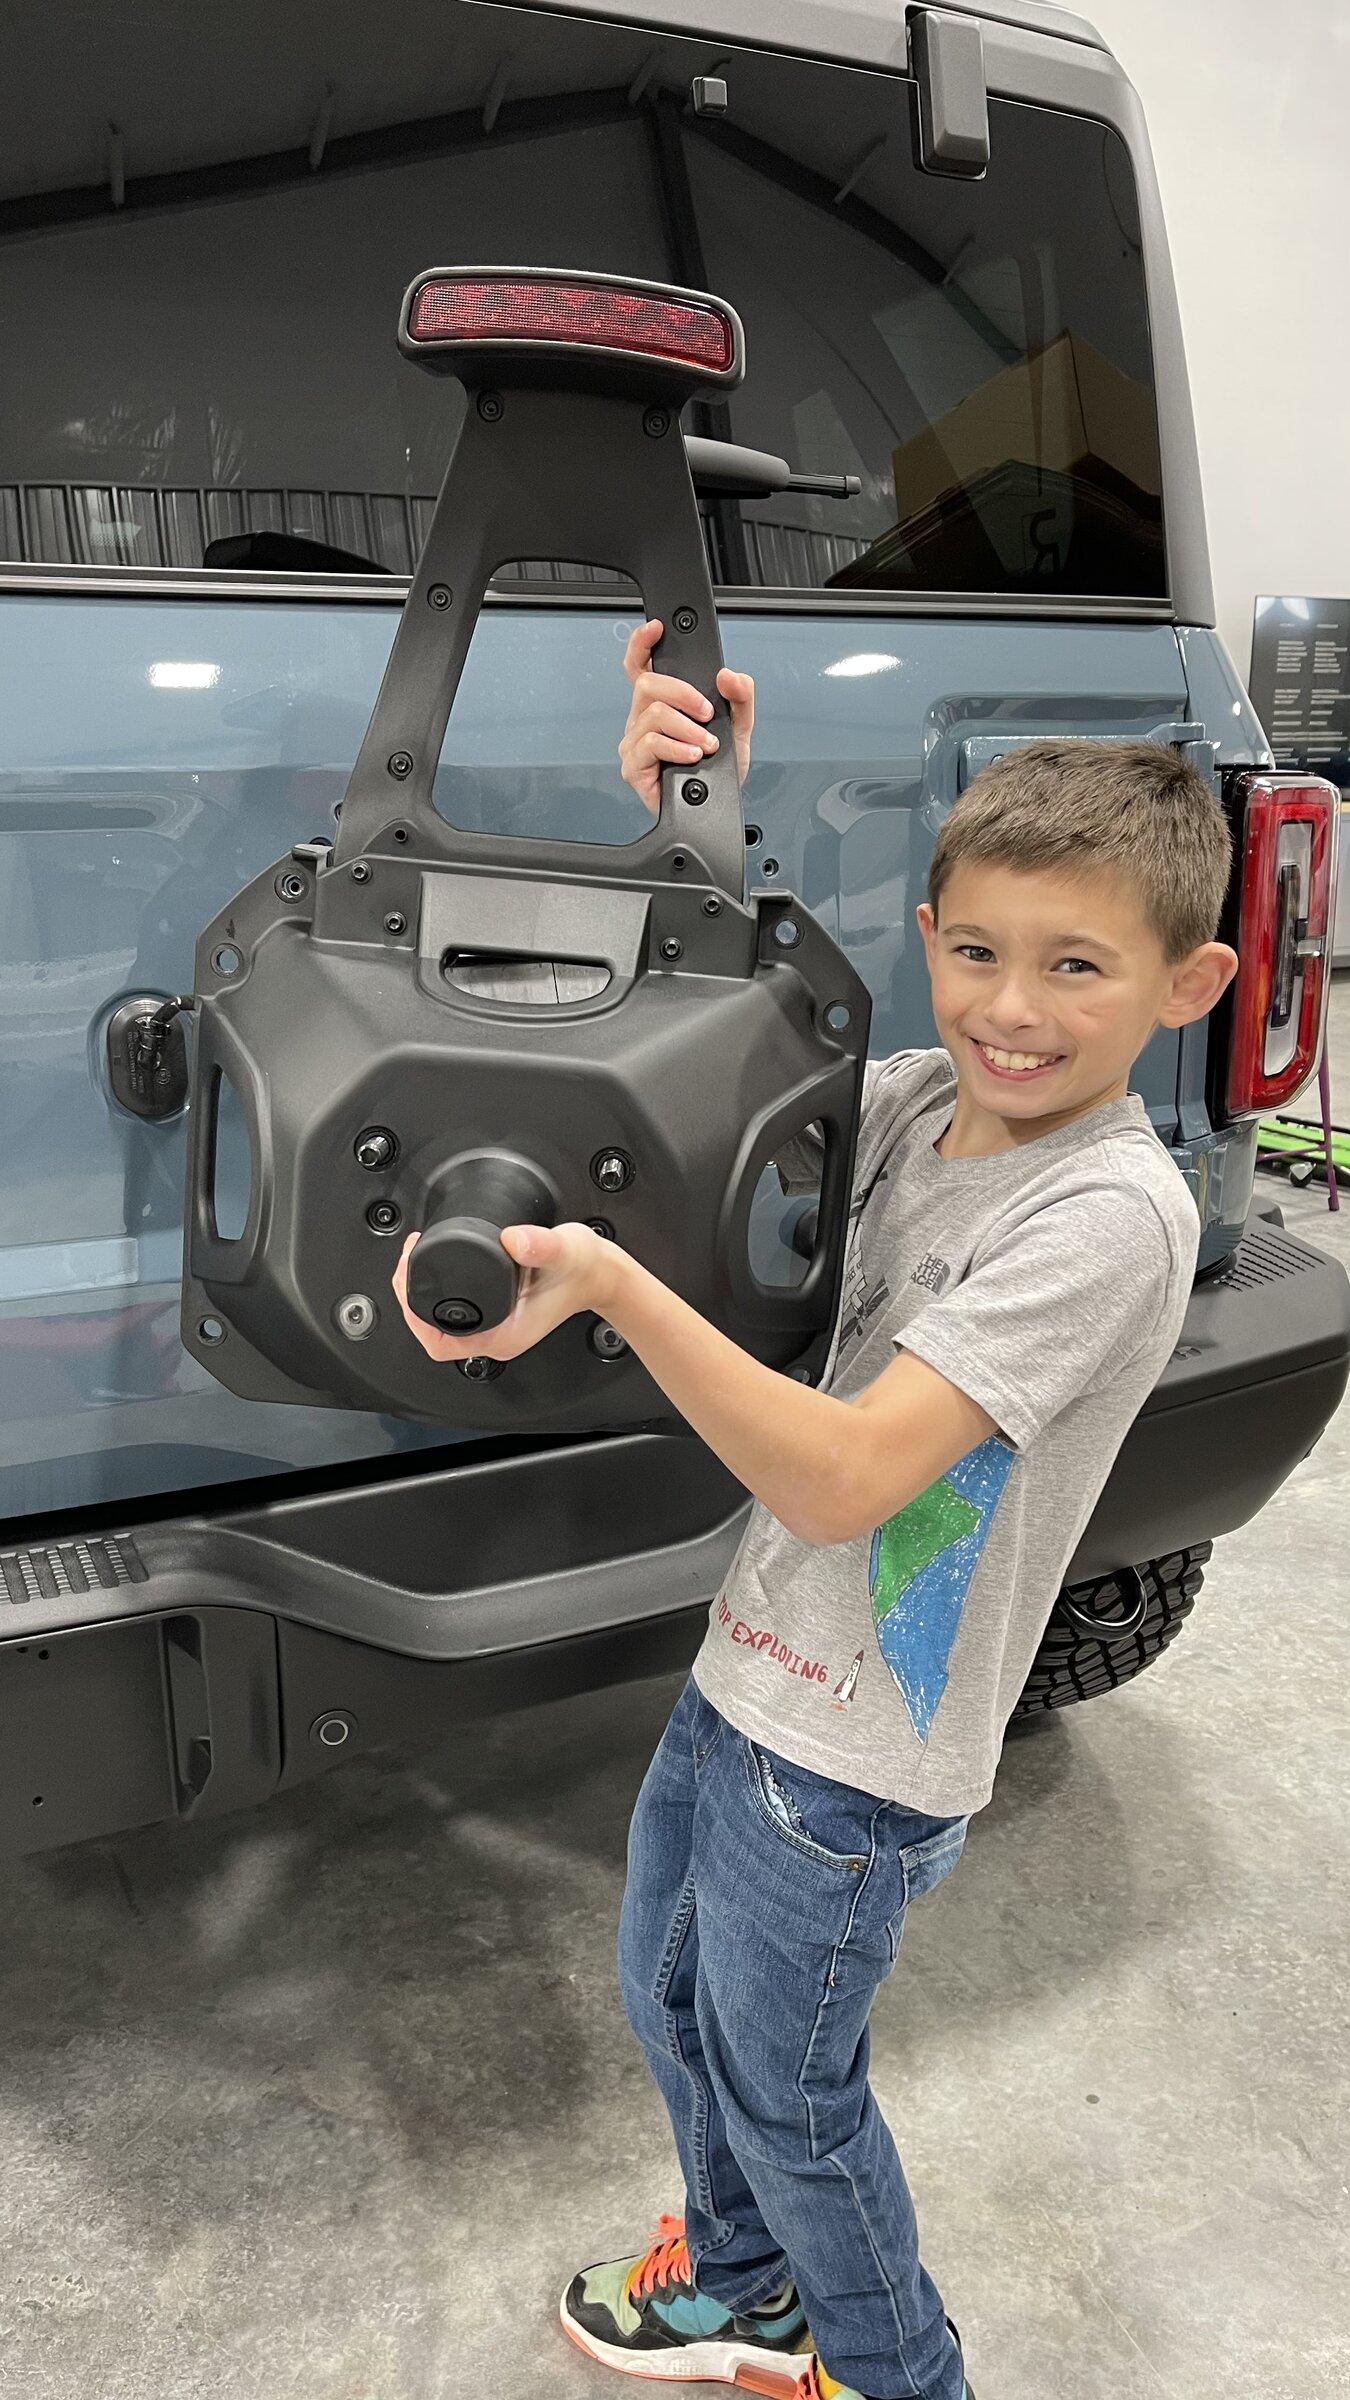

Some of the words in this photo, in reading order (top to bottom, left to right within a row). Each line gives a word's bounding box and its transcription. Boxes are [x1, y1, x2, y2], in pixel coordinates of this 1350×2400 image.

[916, 1261, 940, 1281] RTH
[920, 1252, 945, 1271] THE
[910, 1271, 935, 1290] ACE
[717, 1593, 732, 1627] TOP
